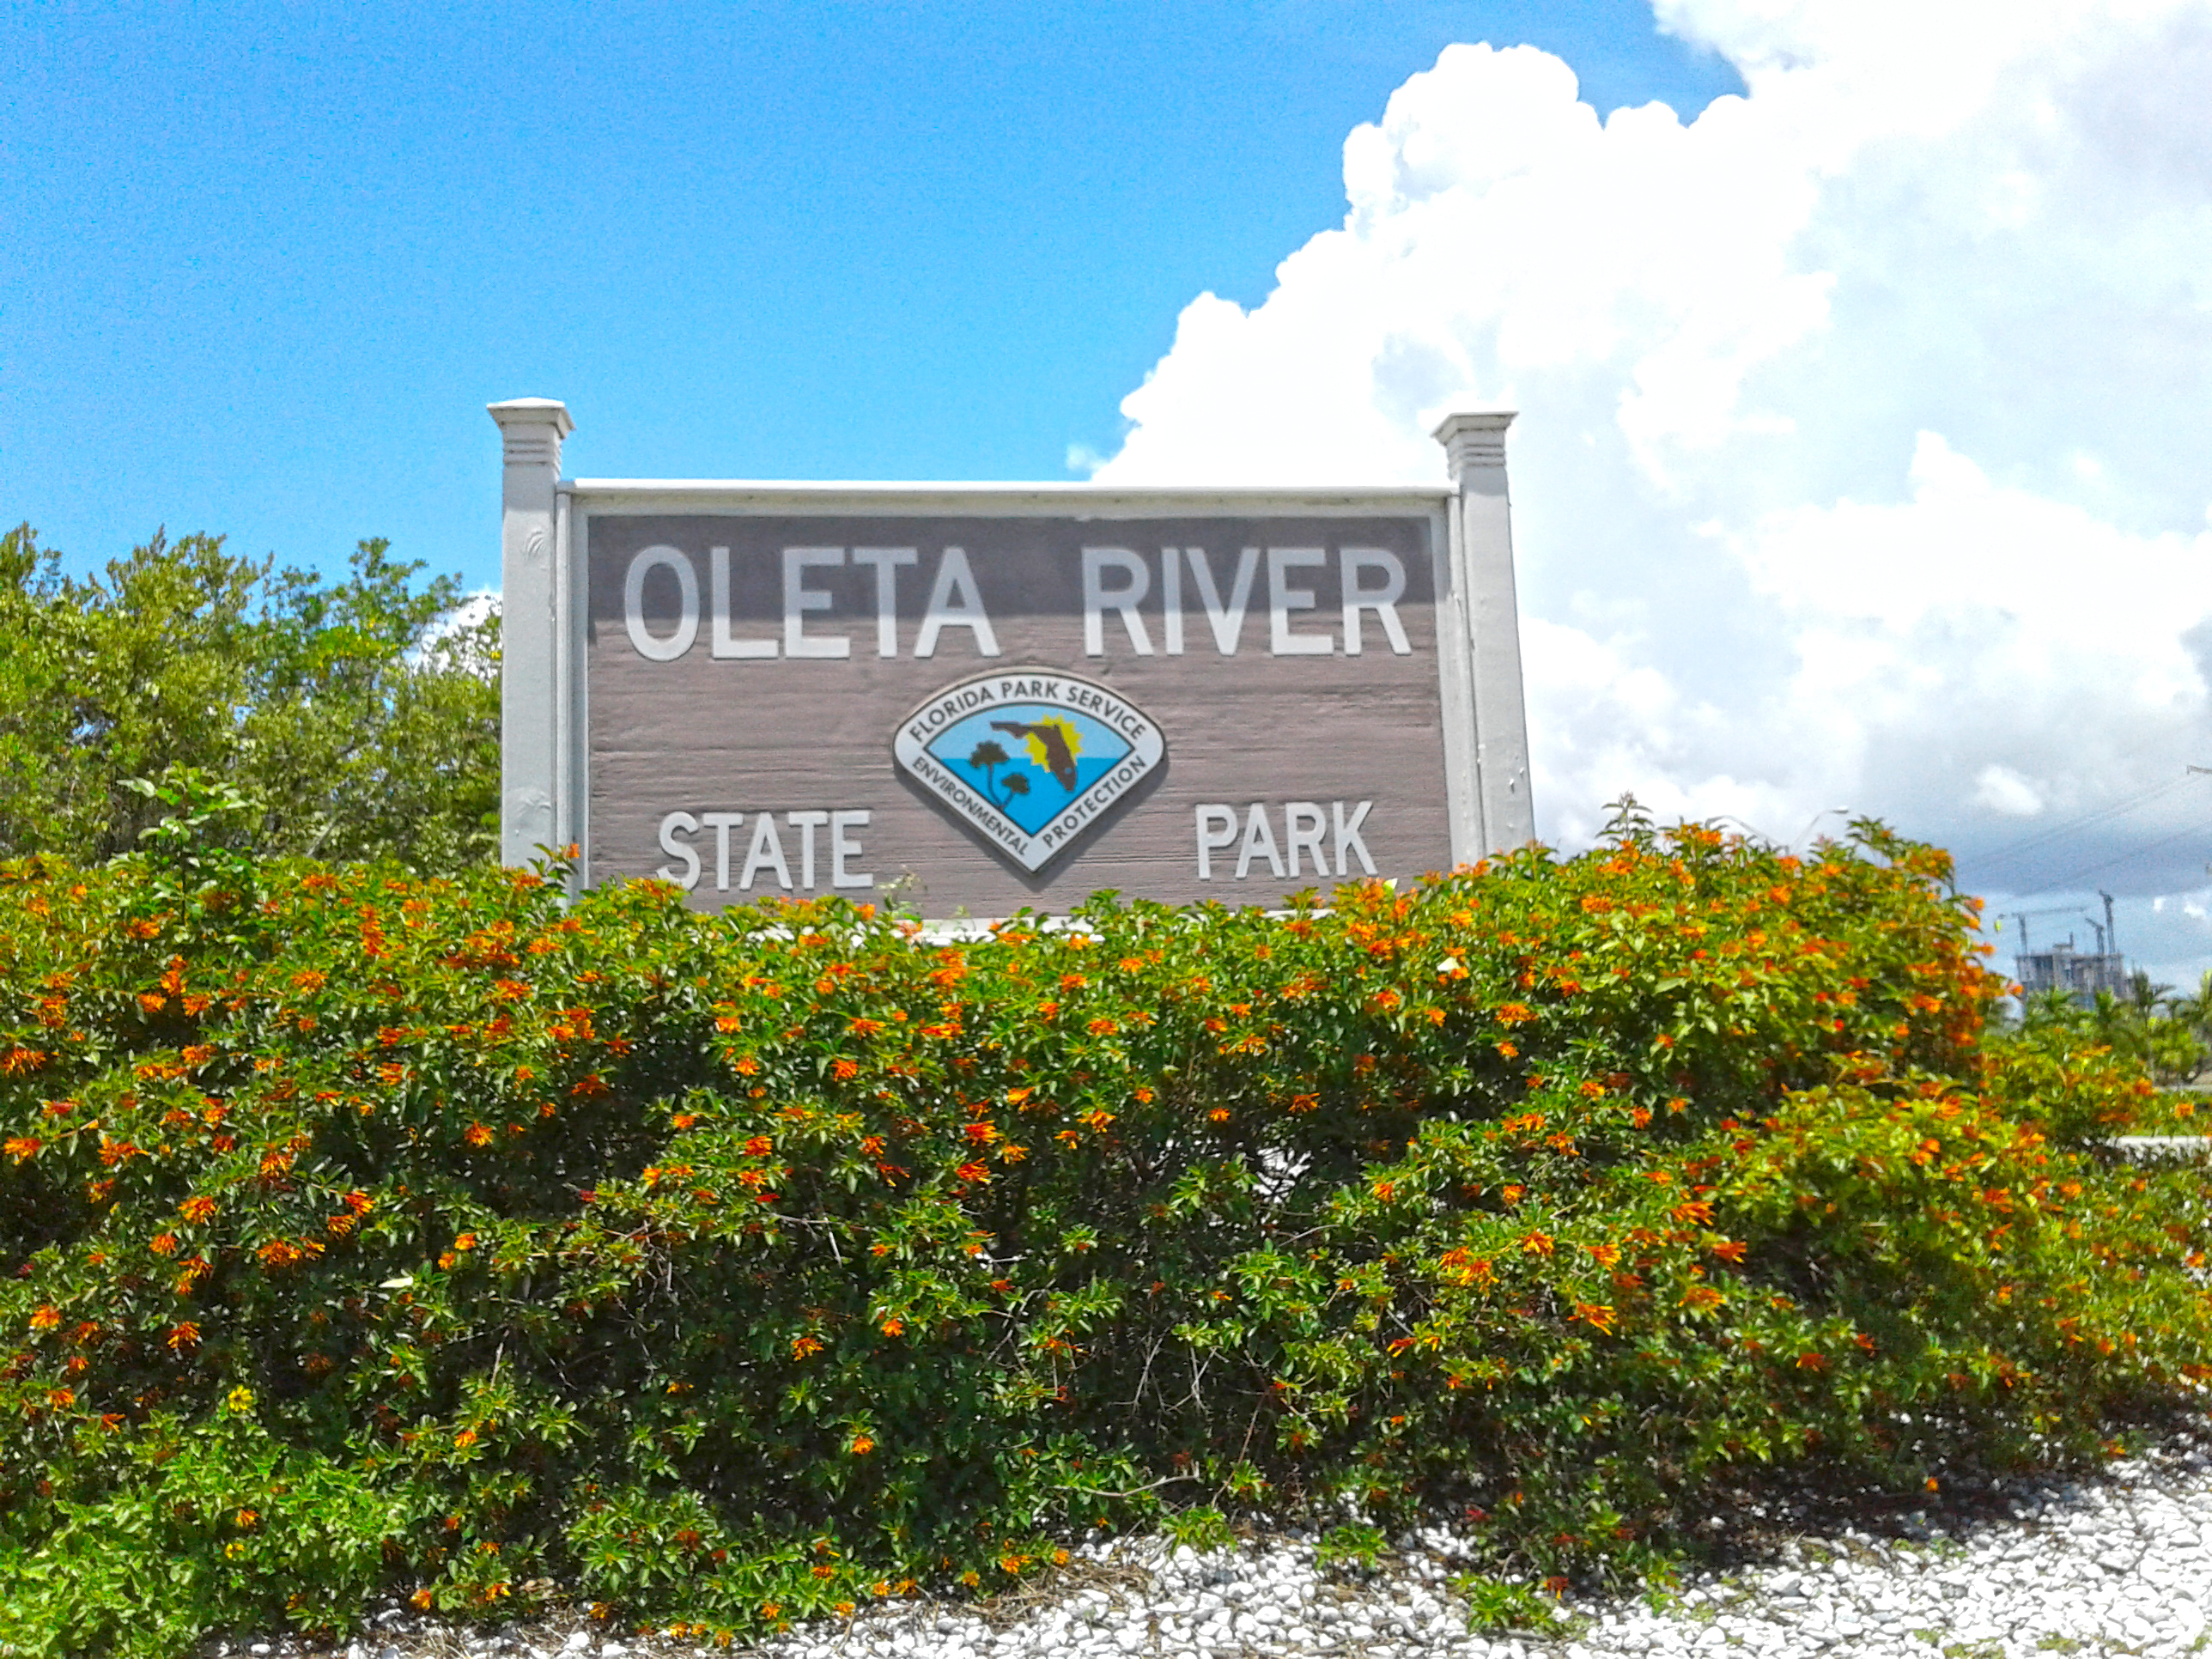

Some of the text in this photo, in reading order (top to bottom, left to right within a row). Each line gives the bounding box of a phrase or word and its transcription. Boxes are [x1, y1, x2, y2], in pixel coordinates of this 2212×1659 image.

[624, 545, 1412, 661] OLETA RIVER
[909, 680, 1146, 742] FLORIDA PARK SERVICE
[656, 800, 1379, 890] STATE PARK
[913, 757, 1029, 856] ENVIRONMENTAL
[1042, 756, 1146, 848] PROTECTION
